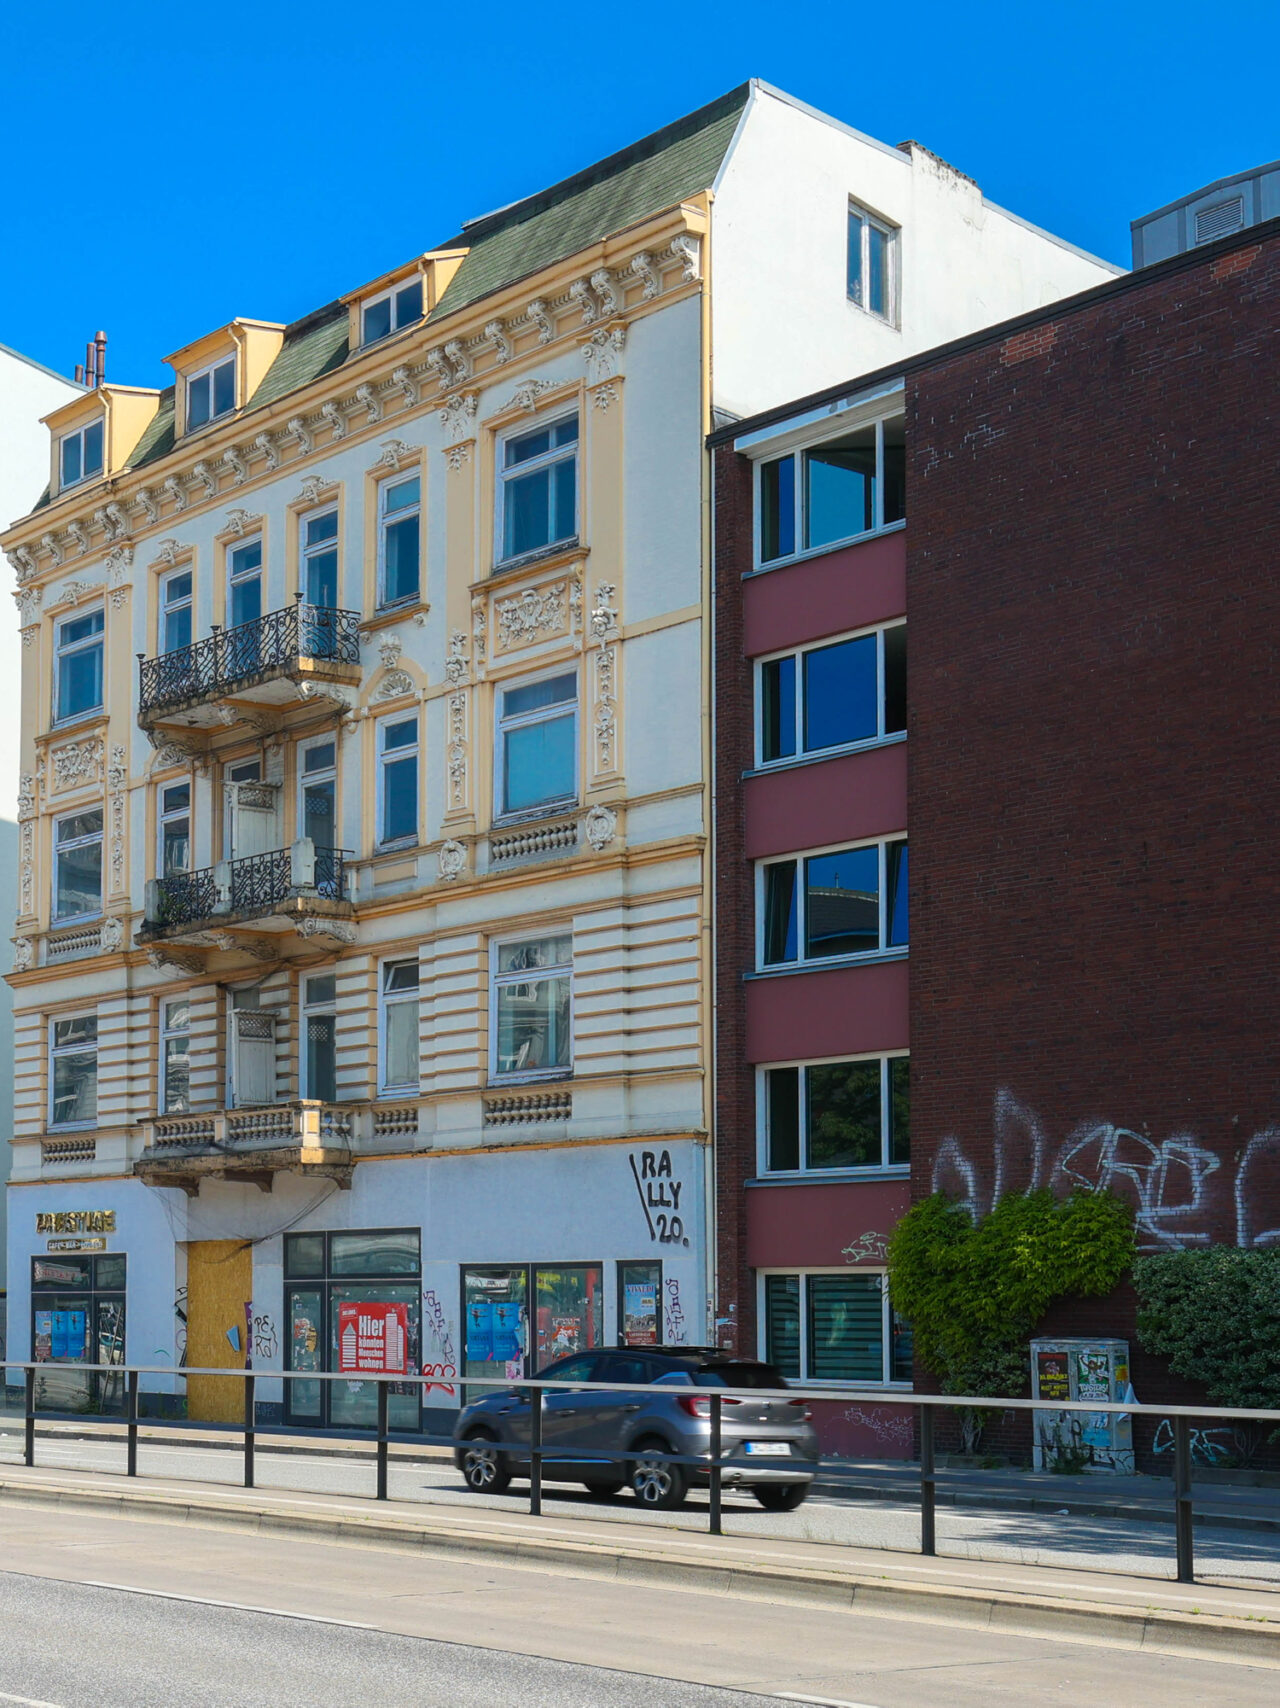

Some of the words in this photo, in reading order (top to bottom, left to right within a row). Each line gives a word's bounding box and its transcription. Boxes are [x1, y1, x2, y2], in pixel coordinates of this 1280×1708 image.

[642, 1150, 672, 1180] RA
[647, 1181, 682, 1210] LLY
[36, 1210, 116, 1233] PRESTIGE
[359, 1315, 384, 1337] Hier
[359, 1336, 384, 1348] könnten
[359, 1348, 384, 1357] Menschen
[359, 1357, 384, 1369] wohnen
